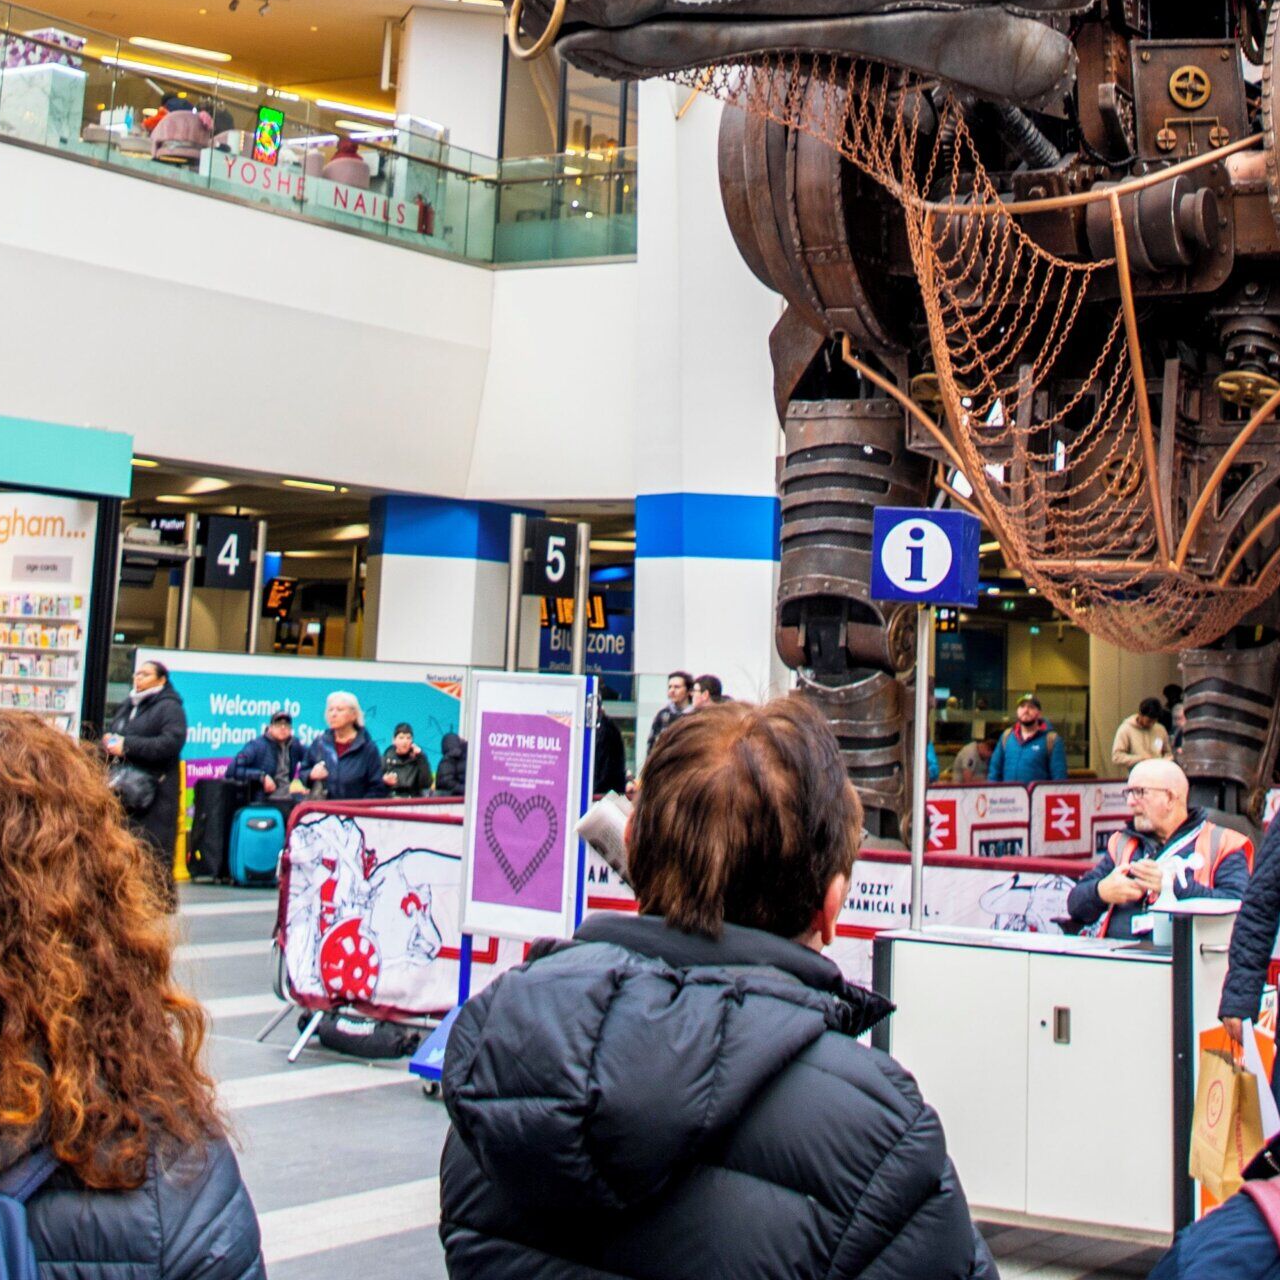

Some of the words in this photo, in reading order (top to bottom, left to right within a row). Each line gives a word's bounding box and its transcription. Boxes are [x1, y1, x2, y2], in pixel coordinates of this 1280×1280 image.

[333, 186, 406, 224] NAILS
[217, 533, 240, 576] 4
[545, 535, 566, 582] 5
[587, 633, 625, 654] zone
[210, 693, 281, 717] Welcome
[283, 698, 301, 718] to
[488, 732, 514, 748] OZZY
[516, 734, 535, 750] THE
[537, 736, 561, 751] BULL
[186, 764, 214, 778] Thank
[856, 882, 894, 896] 'OZZY'
[901, 903, 929, 917] BL
